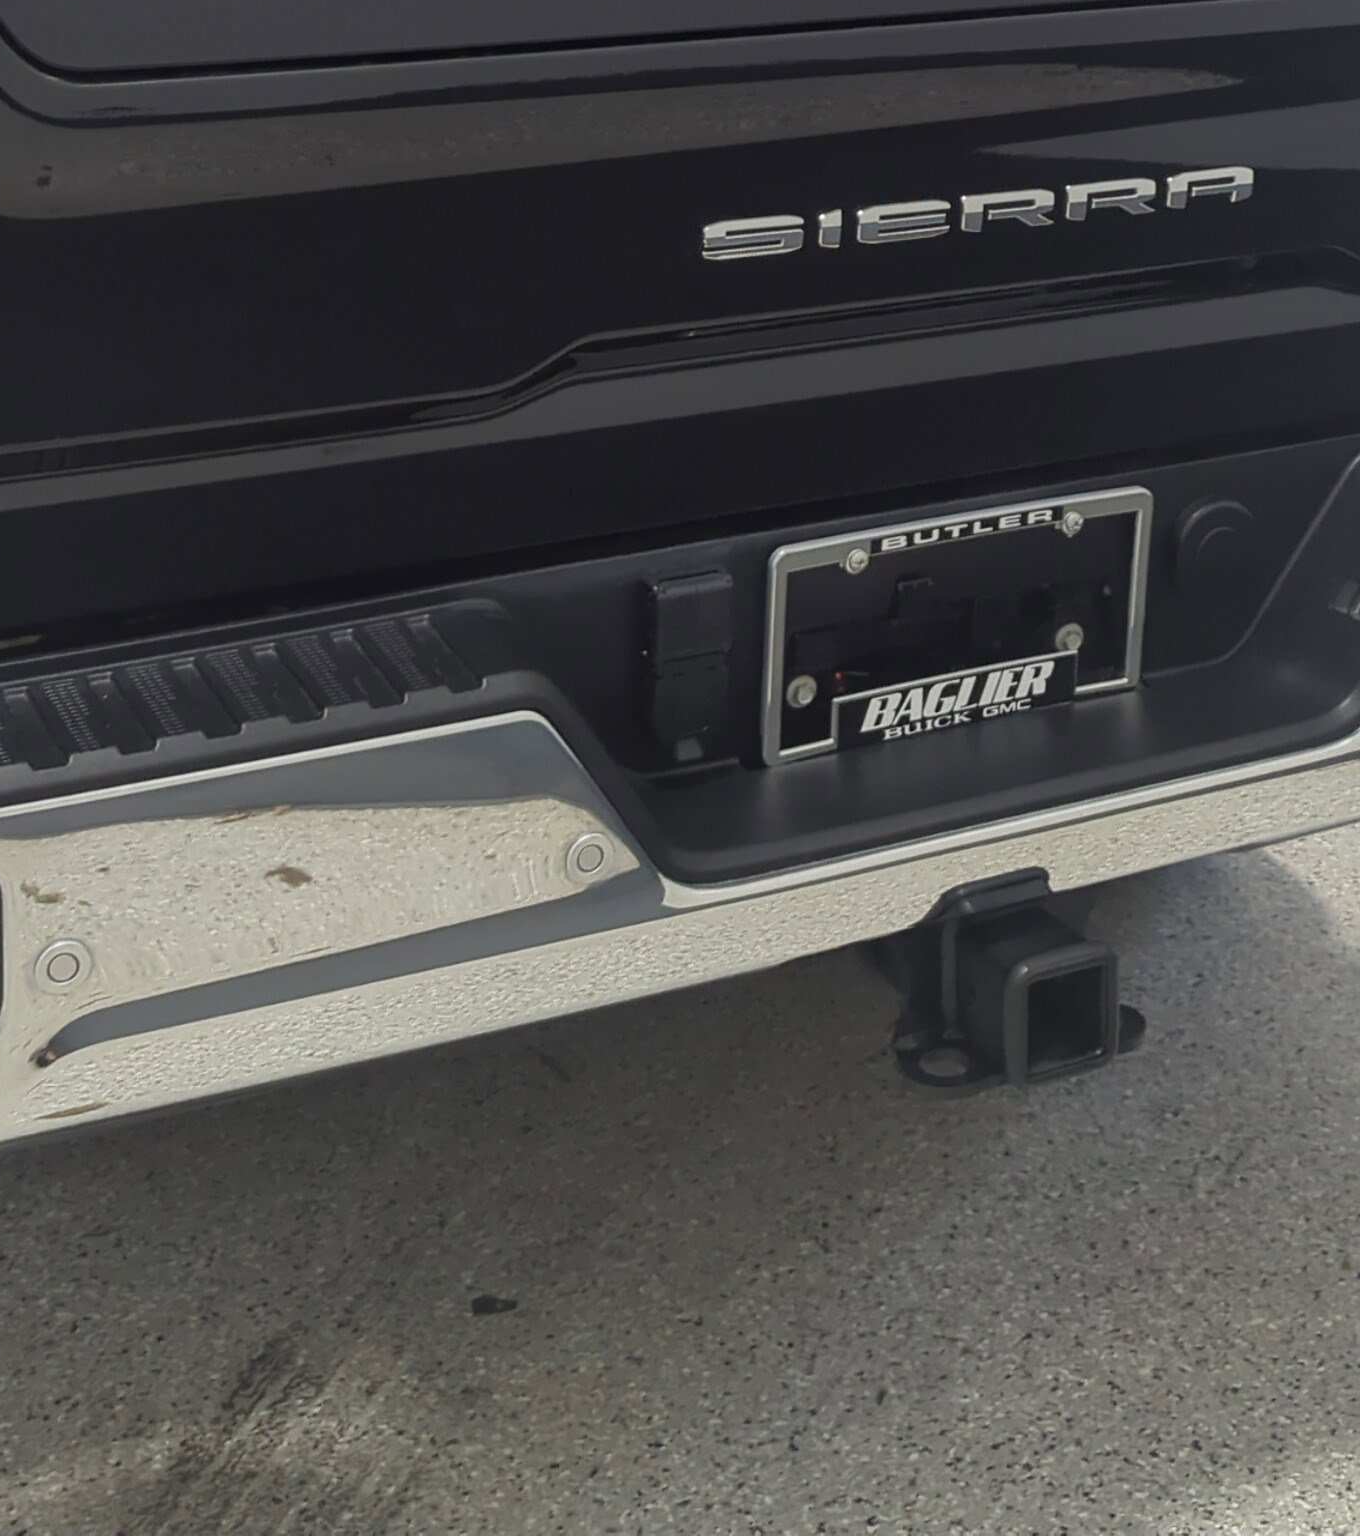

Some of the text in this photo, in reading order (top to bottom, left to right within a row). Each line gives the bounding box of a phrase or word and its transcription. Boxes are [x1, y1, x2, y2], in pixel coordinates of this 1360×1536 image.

[701, 165, 1254, 261] SIERRA
[880, 509, 1053, 552] BUTLER
[860, 661, 1055, 734] BAGLIER
[882, 698, 1032, 741] BUICK GMC
